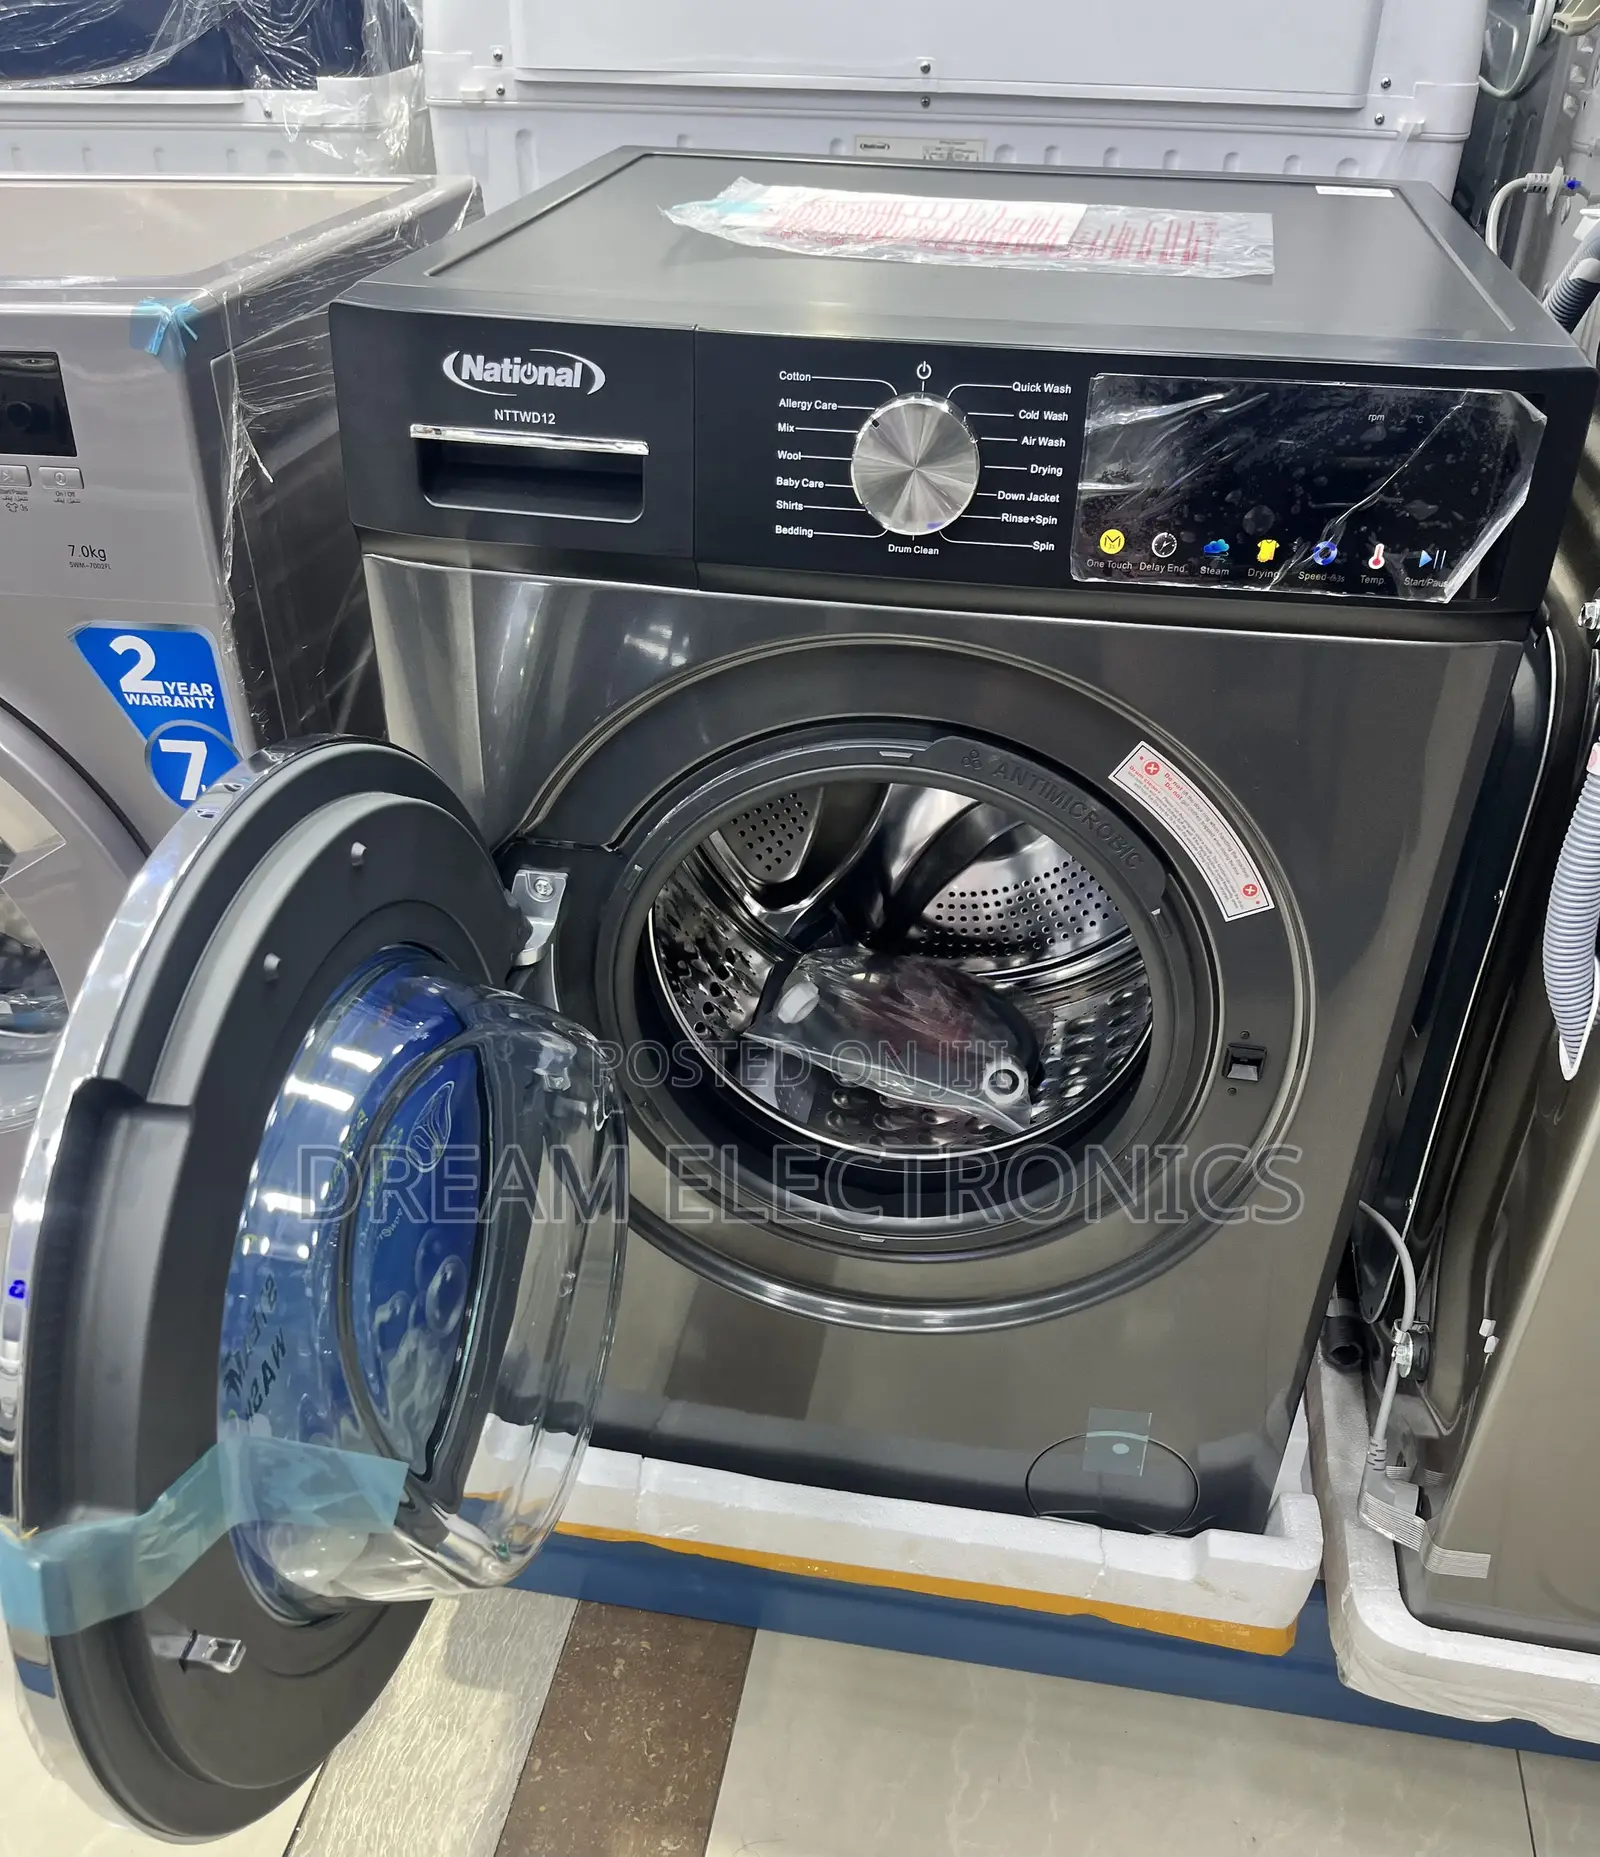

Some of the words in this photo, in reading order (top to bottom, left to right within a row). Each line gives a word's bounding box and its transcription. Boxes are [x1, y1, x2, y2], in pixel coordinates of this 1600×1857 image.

[460, 354, 583, 388] National
[778, 371, 811, 382] Cotton
[1012, 381, 1041, 393] Quick
[1043, 383, 1072, 394] Wash
[778, 398, 808, 411] Allergy
[809, 400, 838, 411] Care
[494, 409, 556, 424] NTTWD12
[1018, 409, 1040, 420] Cold
[1043, 411, 1069, 422] Wash
[1368, 414, 1385, 423] rpm
[777, 423, 795, 433] Mix
[1021, 435, 1037, 446] Air
[1038, 437, 1066, 448] Wash
[777, 450, 801, 461] Wool
[1030, 464, 1063, 477] Drying
[776, 476, 801, 489] Baby
[802, 478, 825, 489] Care
[997, 491, 1025, 502] Down
[1026, 492, 1060, 503] Jacket
[775, 500, 803, 511] Shirts
[1000, 512, 1058, 526] Rinse+Spin
[775, 525, 814, 539] Bedding
[67, 544, 107, 562] 7.0kg
[887, 543, 912, 554] Drum
[913, 545, 940, 556] Clean
[1032, 540, 1055, 553] Spin
[1086, 558, 1105, 569] One
[1107, 560, 1132, 570] Touch
[1139, 561, 1165, 573] Delay
[1200, 566, 1230, 576] Steam
[109, 634, 166, 695] 2
[163, 681, 215, 697] YEAR
[123, 693, 215, 710] WARRANTY
[992, 763, 1145, 870] ANTIMICROBIC
